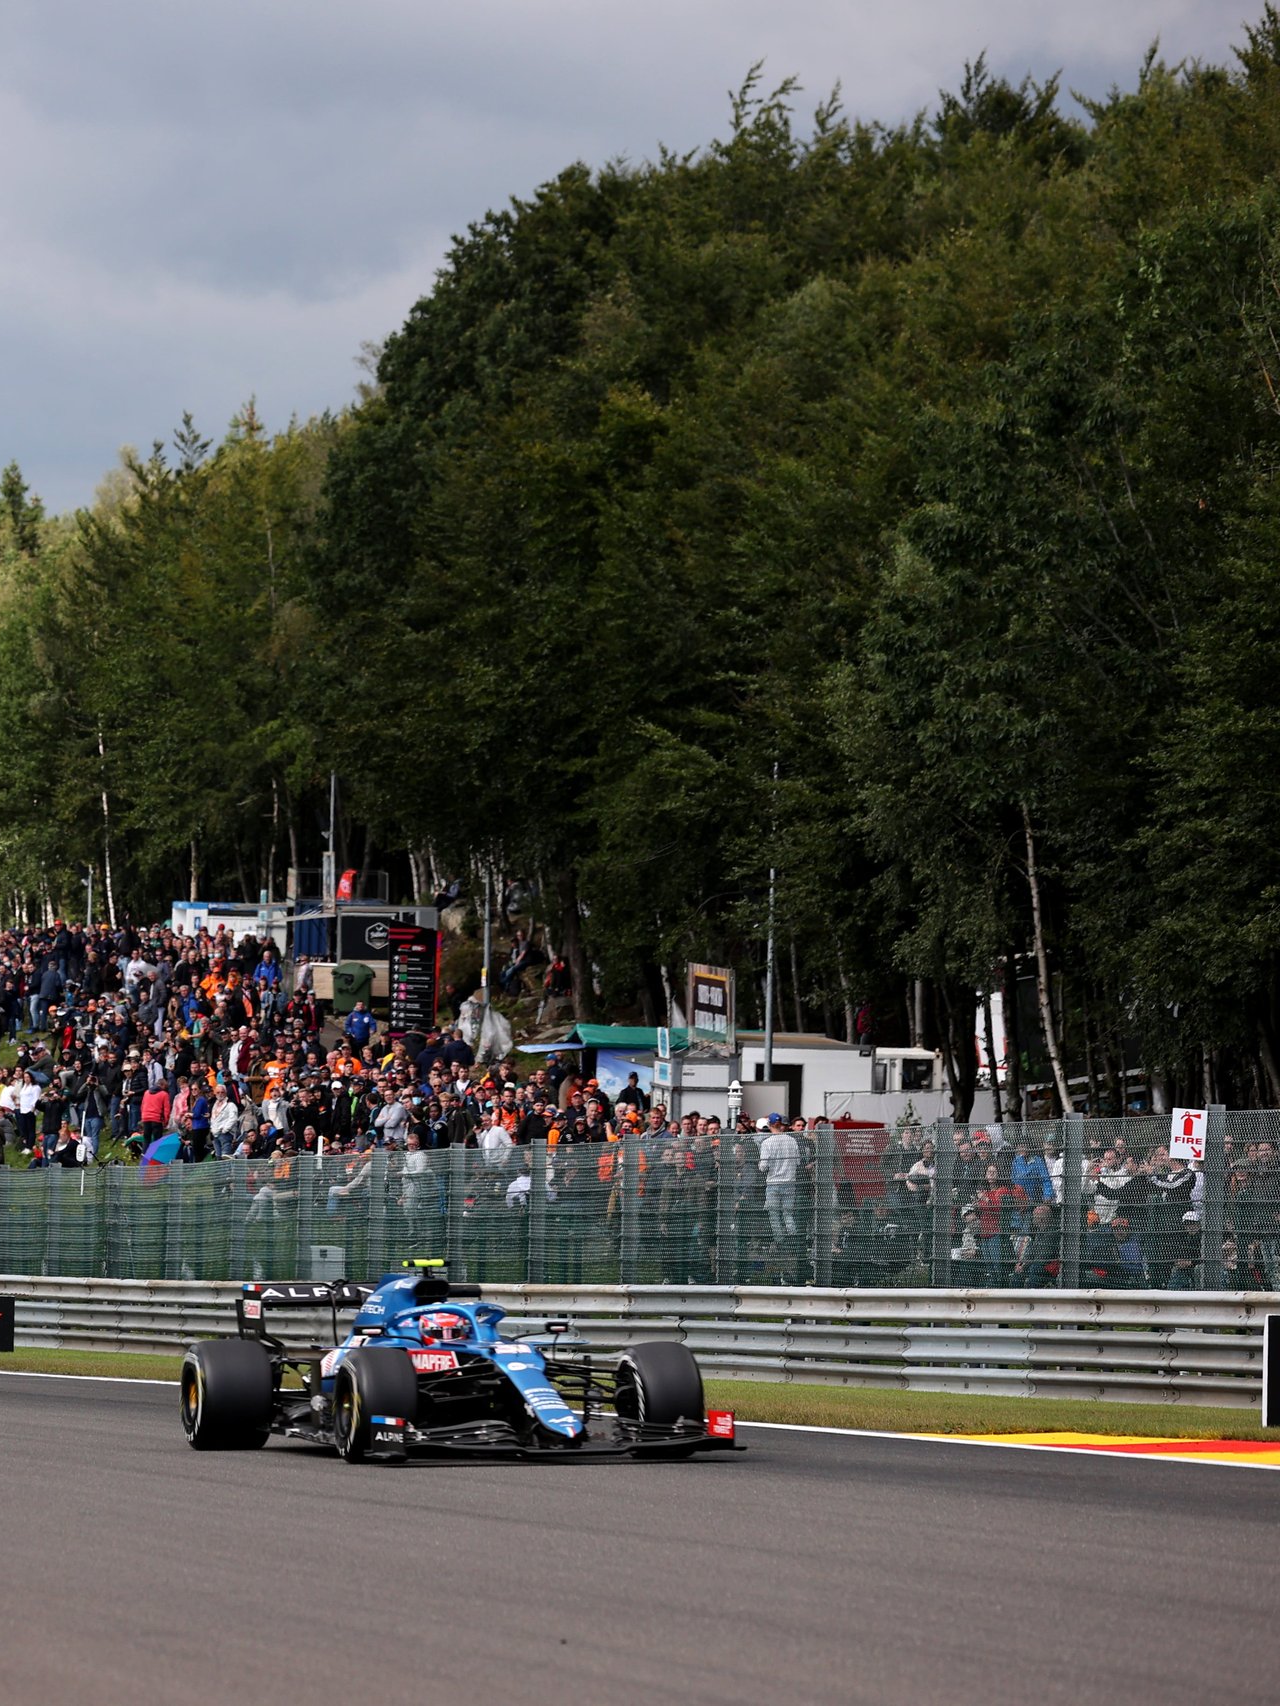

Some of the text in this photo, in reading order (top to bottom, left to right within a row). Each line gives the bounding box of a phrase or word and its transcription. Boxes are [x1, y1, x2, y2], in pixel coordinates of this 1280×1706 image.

[1174, 1136, 1203, 1145] FIRE
[261, 1286, 374, 1298] ALPI
[412, 1353, 454, 1370] MAPFRE
[375, 1431, 404, 1443] ALPINE
